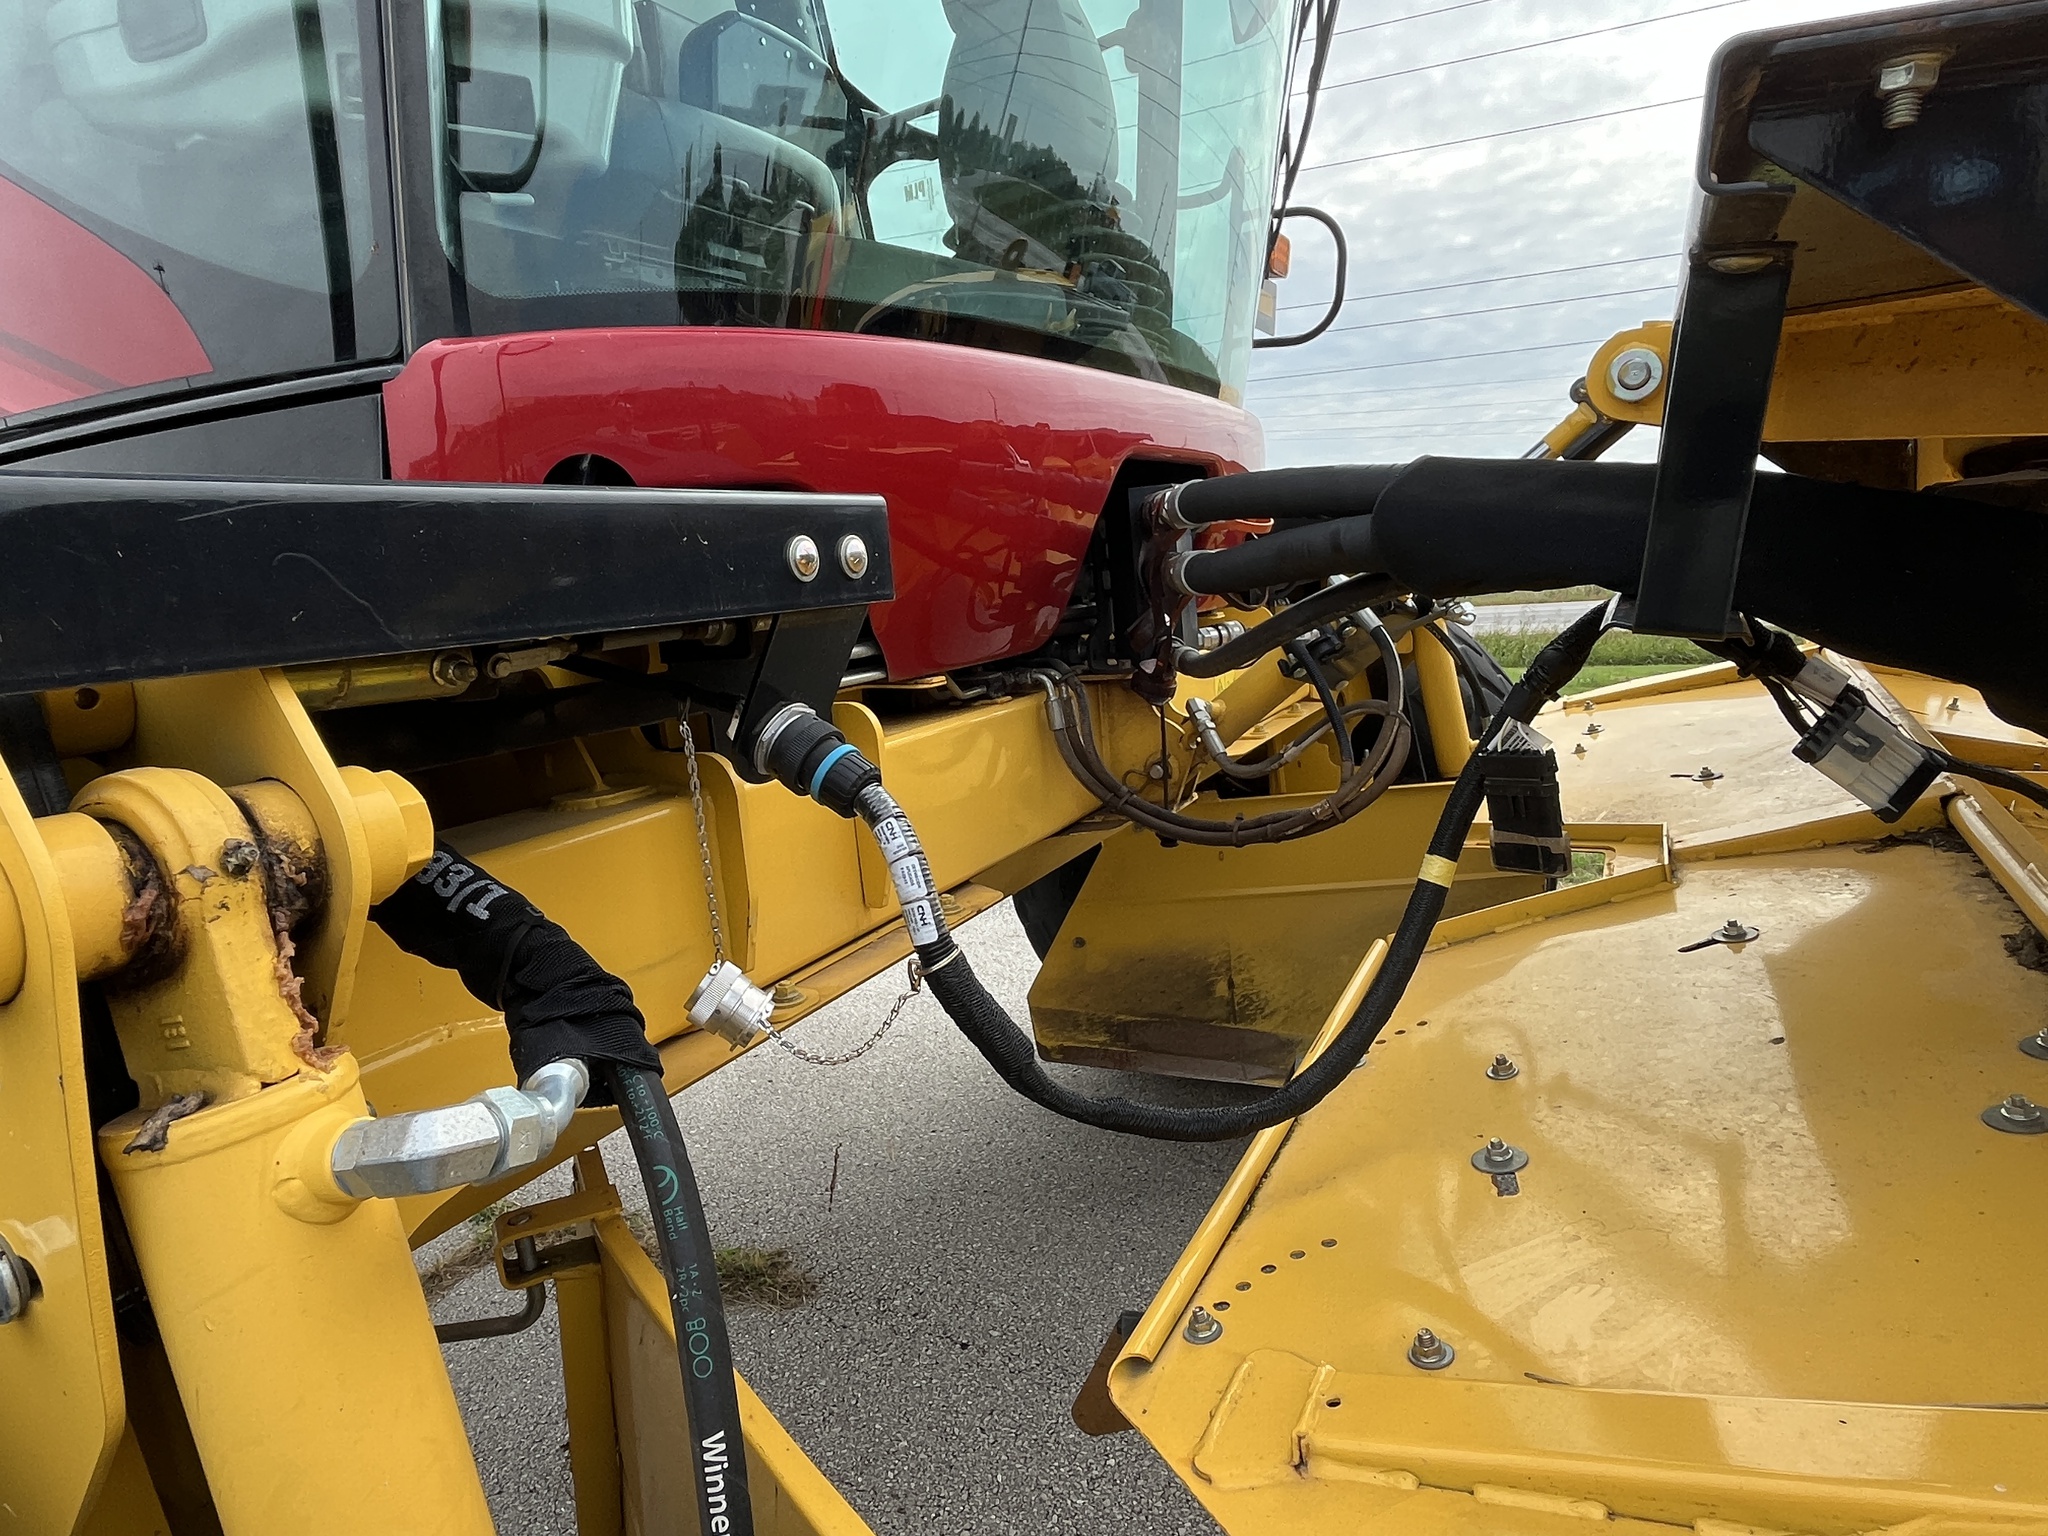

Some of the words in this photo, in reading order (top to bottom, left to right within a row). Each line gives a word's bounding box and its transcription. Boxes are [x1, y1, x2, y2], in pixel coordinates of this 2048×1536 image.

[885, 821, 898, 841] CNH
[916, 904, 928, 928] CNH
[664, 1208, 679, 1241] Bend
[674, 1206, 688, 1231] Half
[702, 1430, 731, 1536] Winne
